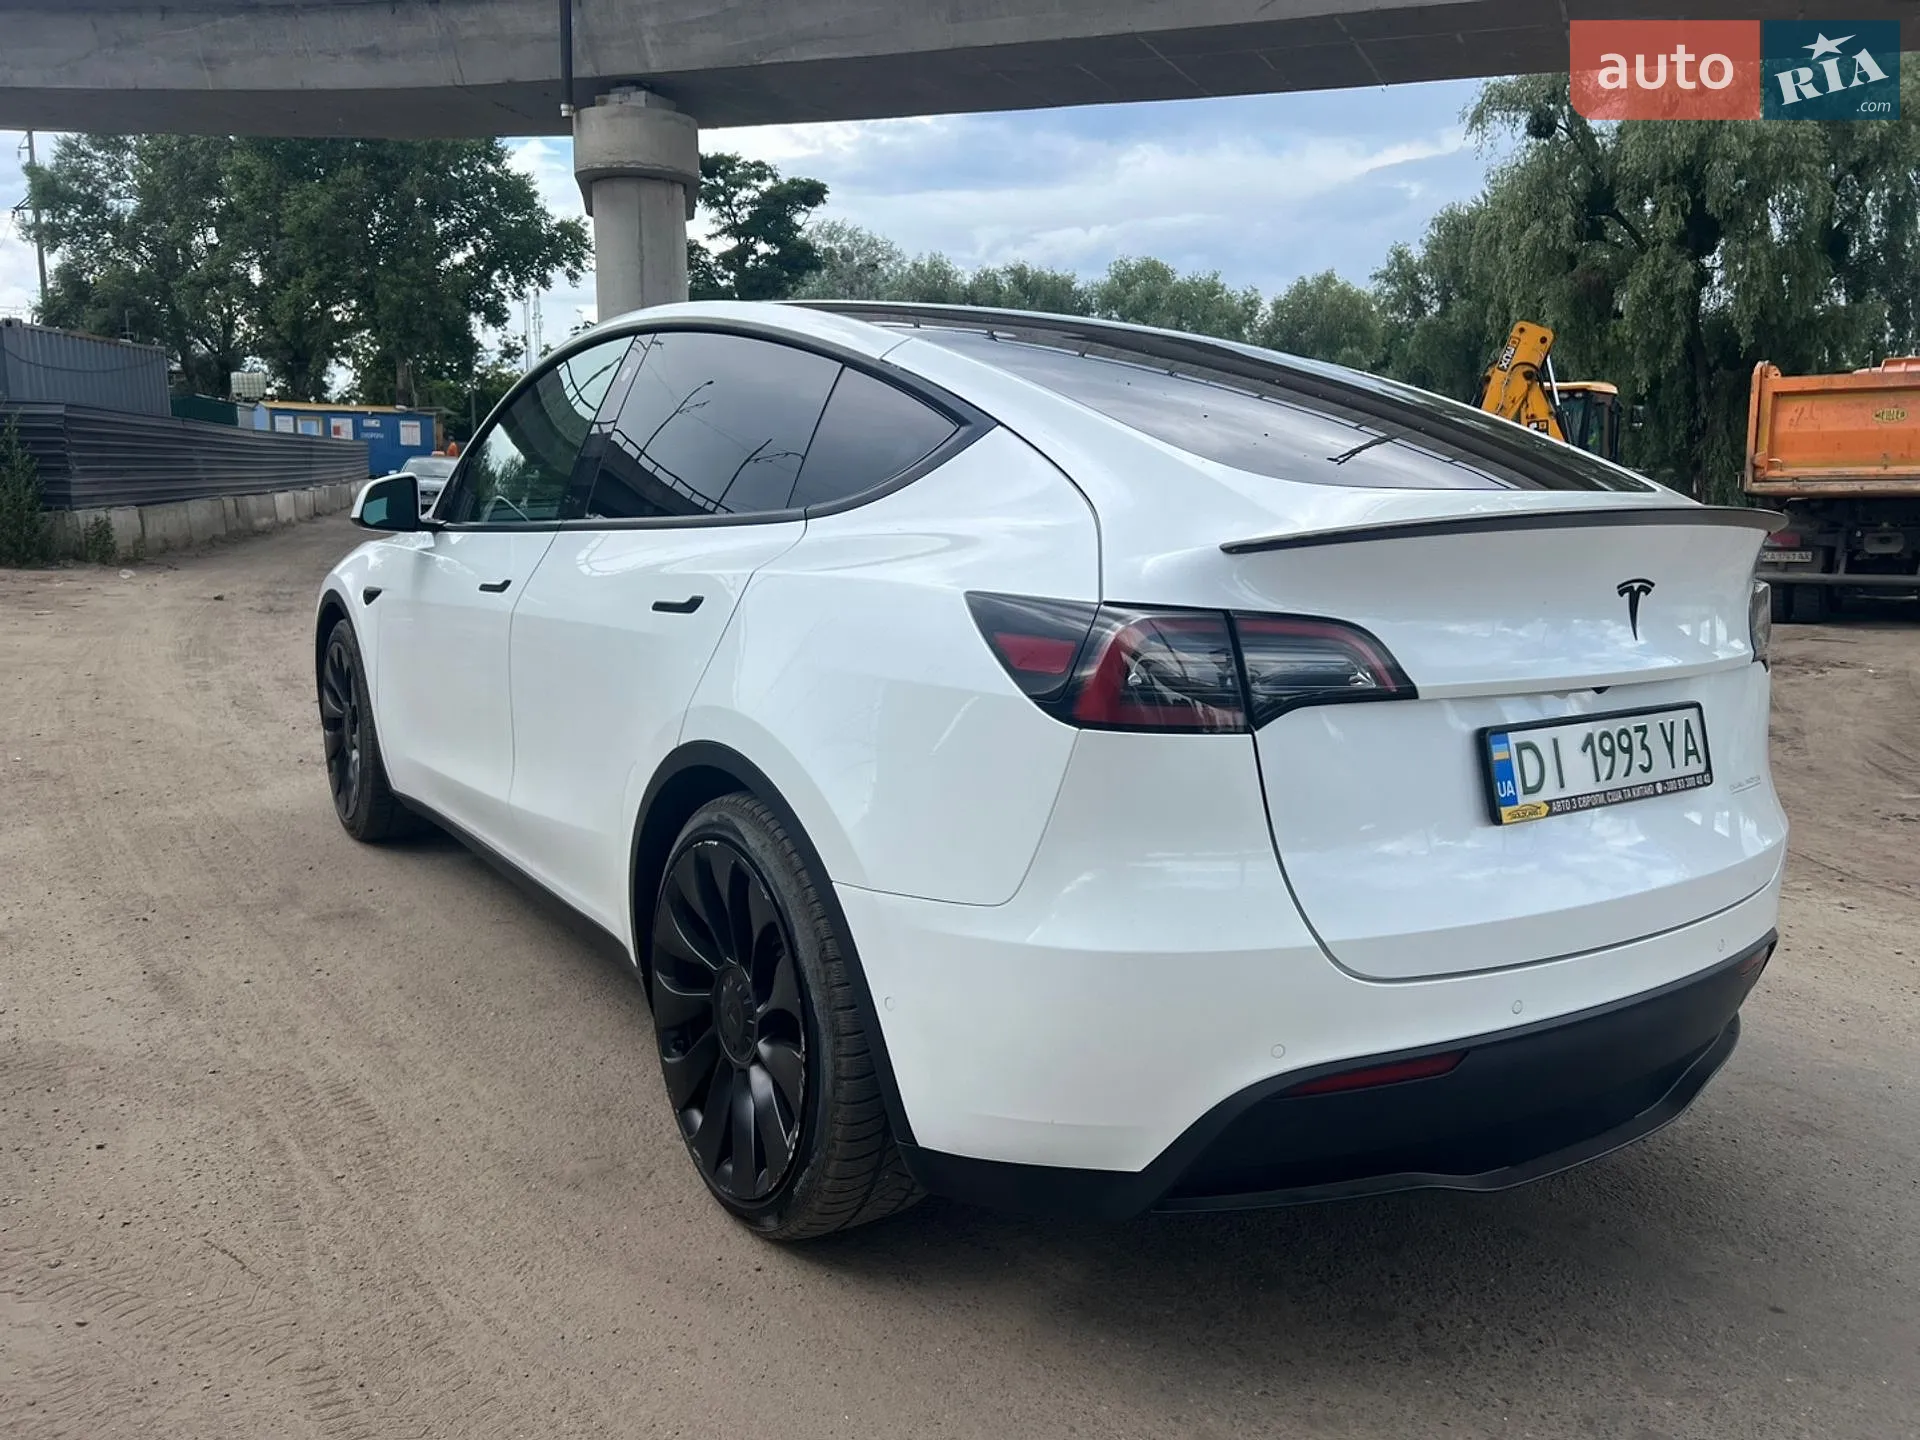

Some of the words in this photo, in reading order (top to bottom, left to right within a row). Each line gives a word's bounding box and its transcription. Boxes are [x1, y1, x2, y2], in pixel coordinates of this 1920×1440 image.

[1514, 737, 1565, 795] DI
[1581, 723, 1654, 783] 1993
[1658, 718, 1702, 769] YA
[1497, 781, 1516, 798] UA
[1552, 797, 1571, 813] АВТО
